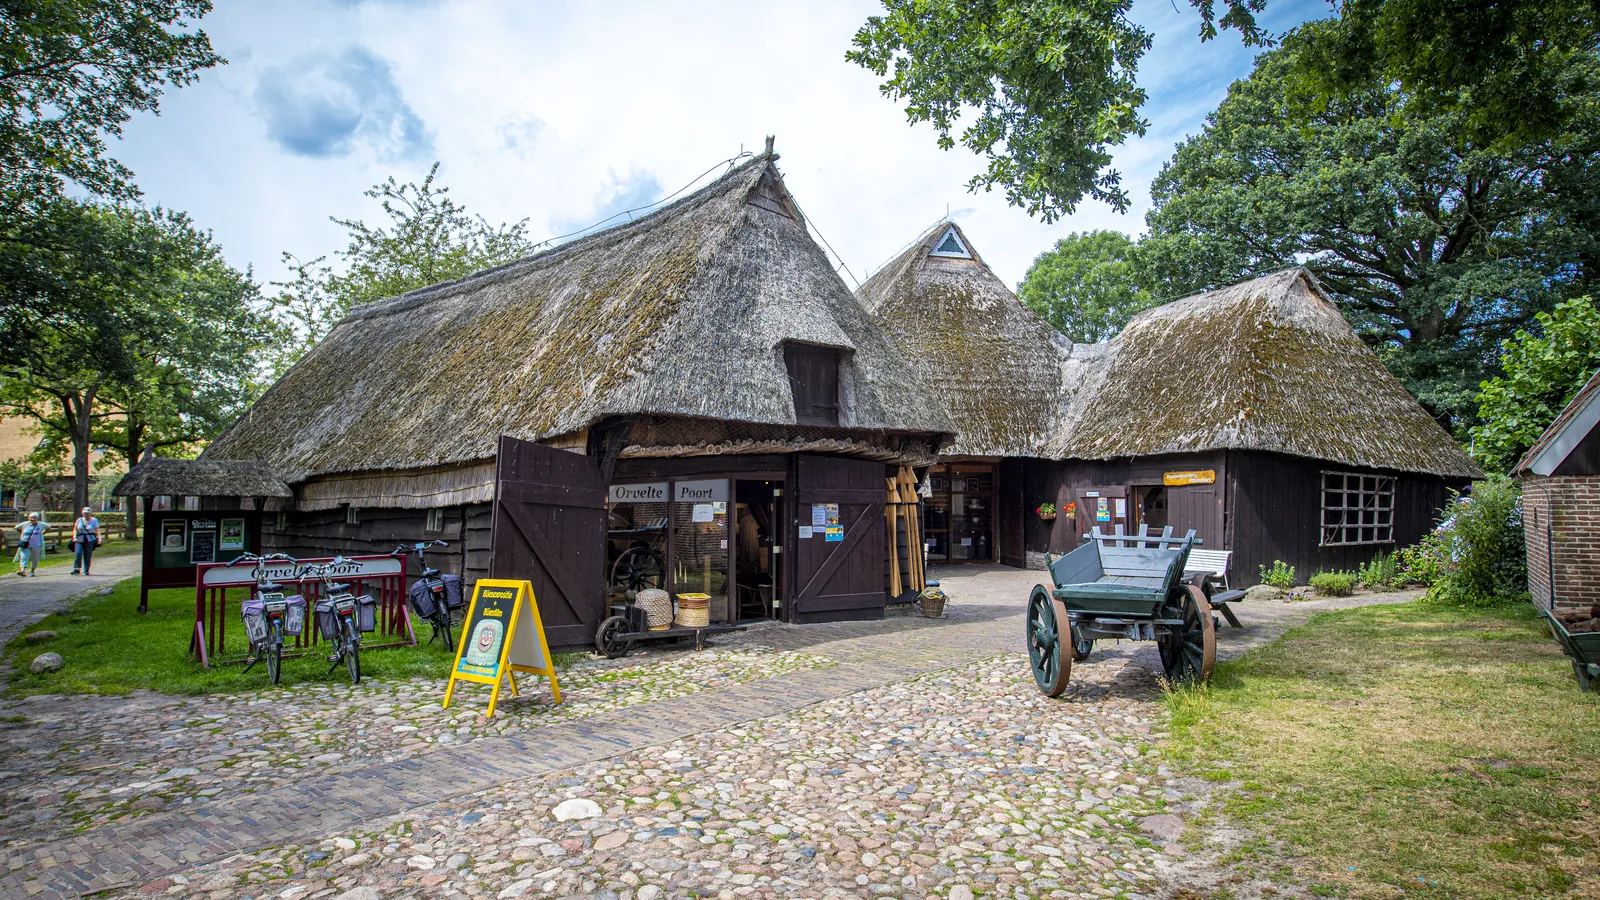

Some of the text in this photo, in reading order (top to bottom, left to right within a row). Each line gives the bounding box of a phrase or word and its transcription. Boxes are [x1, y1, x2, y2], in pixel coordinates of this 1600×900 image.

[615, 486, 713, 499] Orvelte Poort
[251, 563, 318, 579] Orvelt
